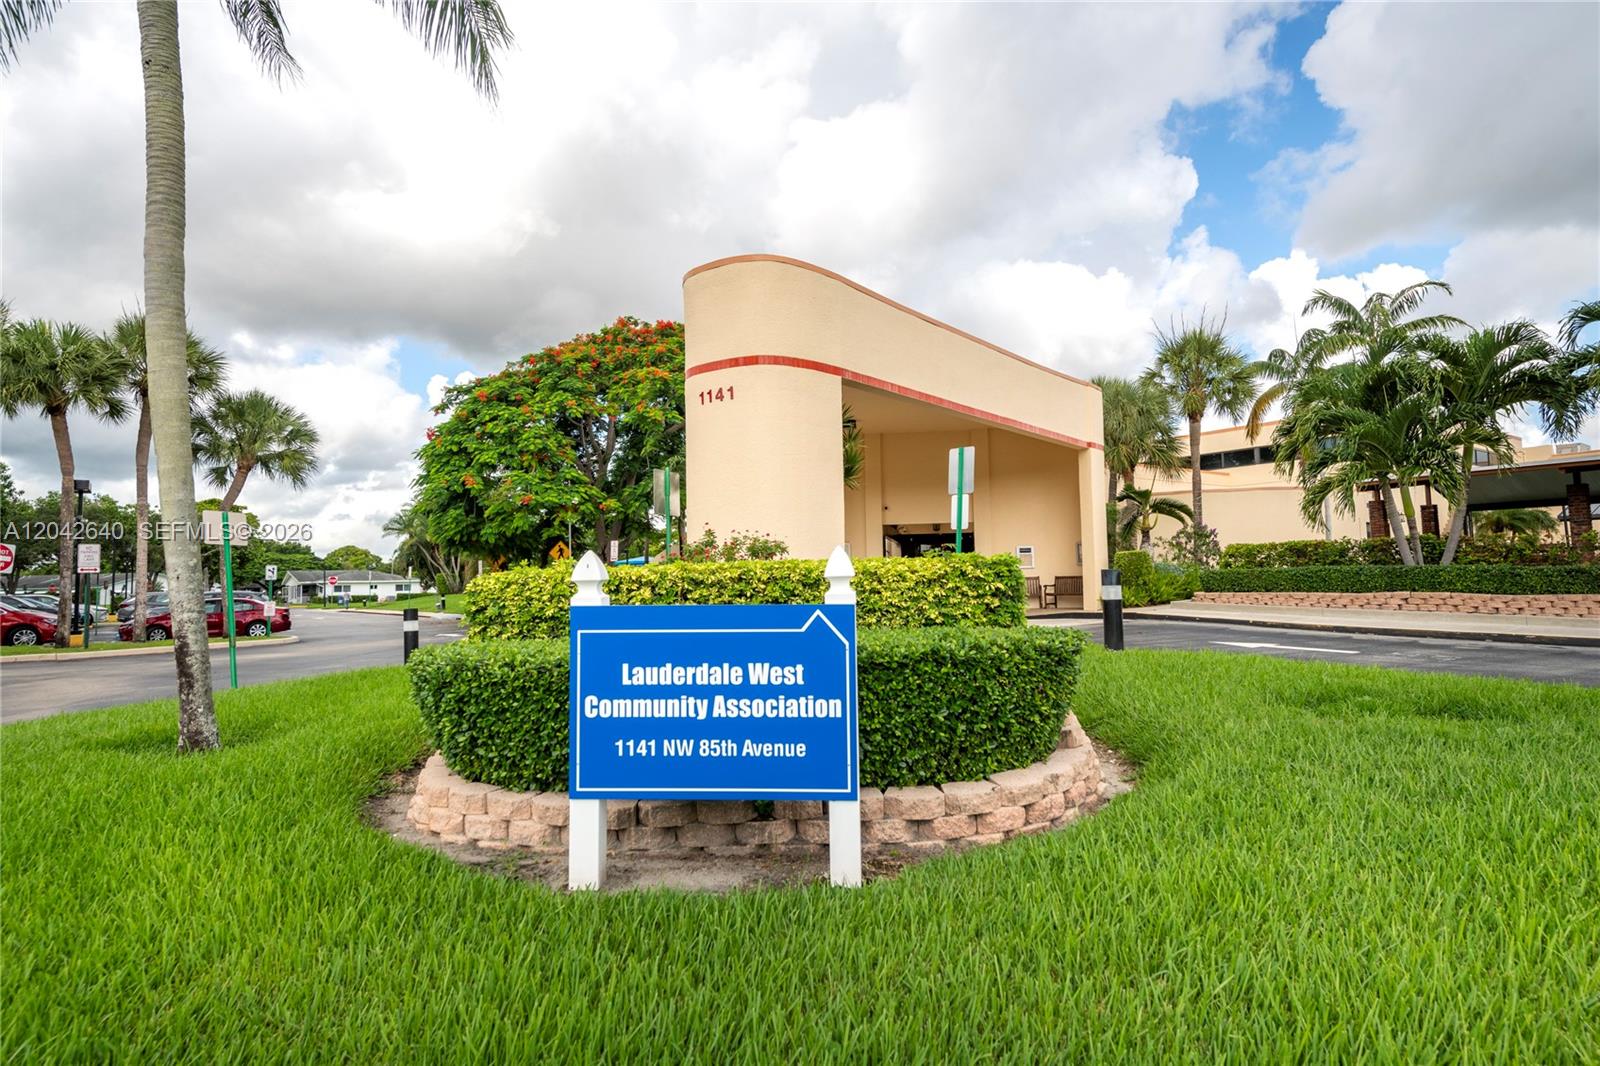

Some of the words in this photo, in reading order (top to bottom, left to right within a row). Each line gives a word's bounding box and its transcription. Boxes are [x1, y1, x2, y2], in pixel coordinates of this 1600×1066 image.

[699, 386, 734, 405] 1141
[622, 662, 743, 686] Lauderdale
[748, 662, 805, 686] West
[584, 694, 708, 720] Community
[712, 694, 842, 719] Association
[614, 739, 656, 757] 1141
[663, 739, 695, 757] NW
[698, 739, 738, 757] 85th
[742, 739, 807, 757] Avenue
